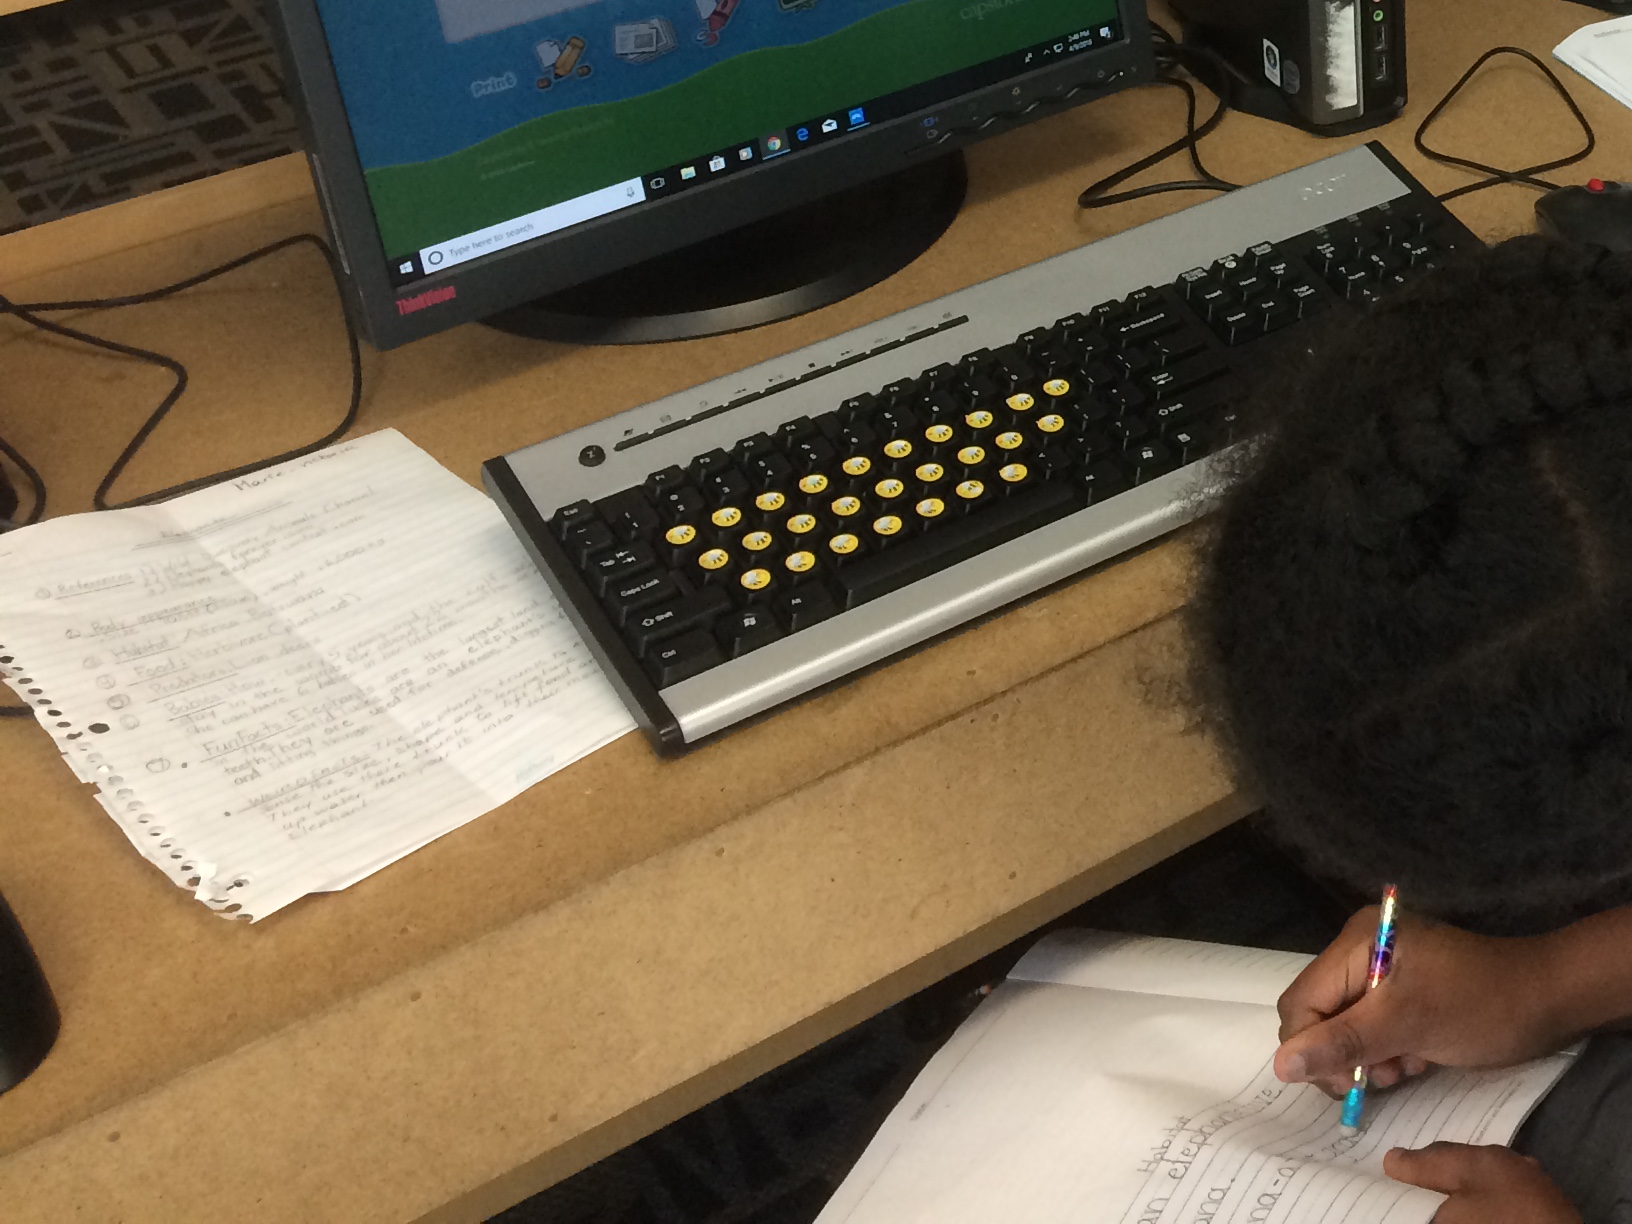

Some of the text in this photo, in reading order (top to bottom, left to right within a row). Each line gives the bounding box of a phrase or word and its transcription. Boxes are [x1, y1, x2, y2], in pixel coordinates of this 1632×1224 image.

[472, 73, 517, 97] Print
[449, 223, 534, 257] Type here to search
